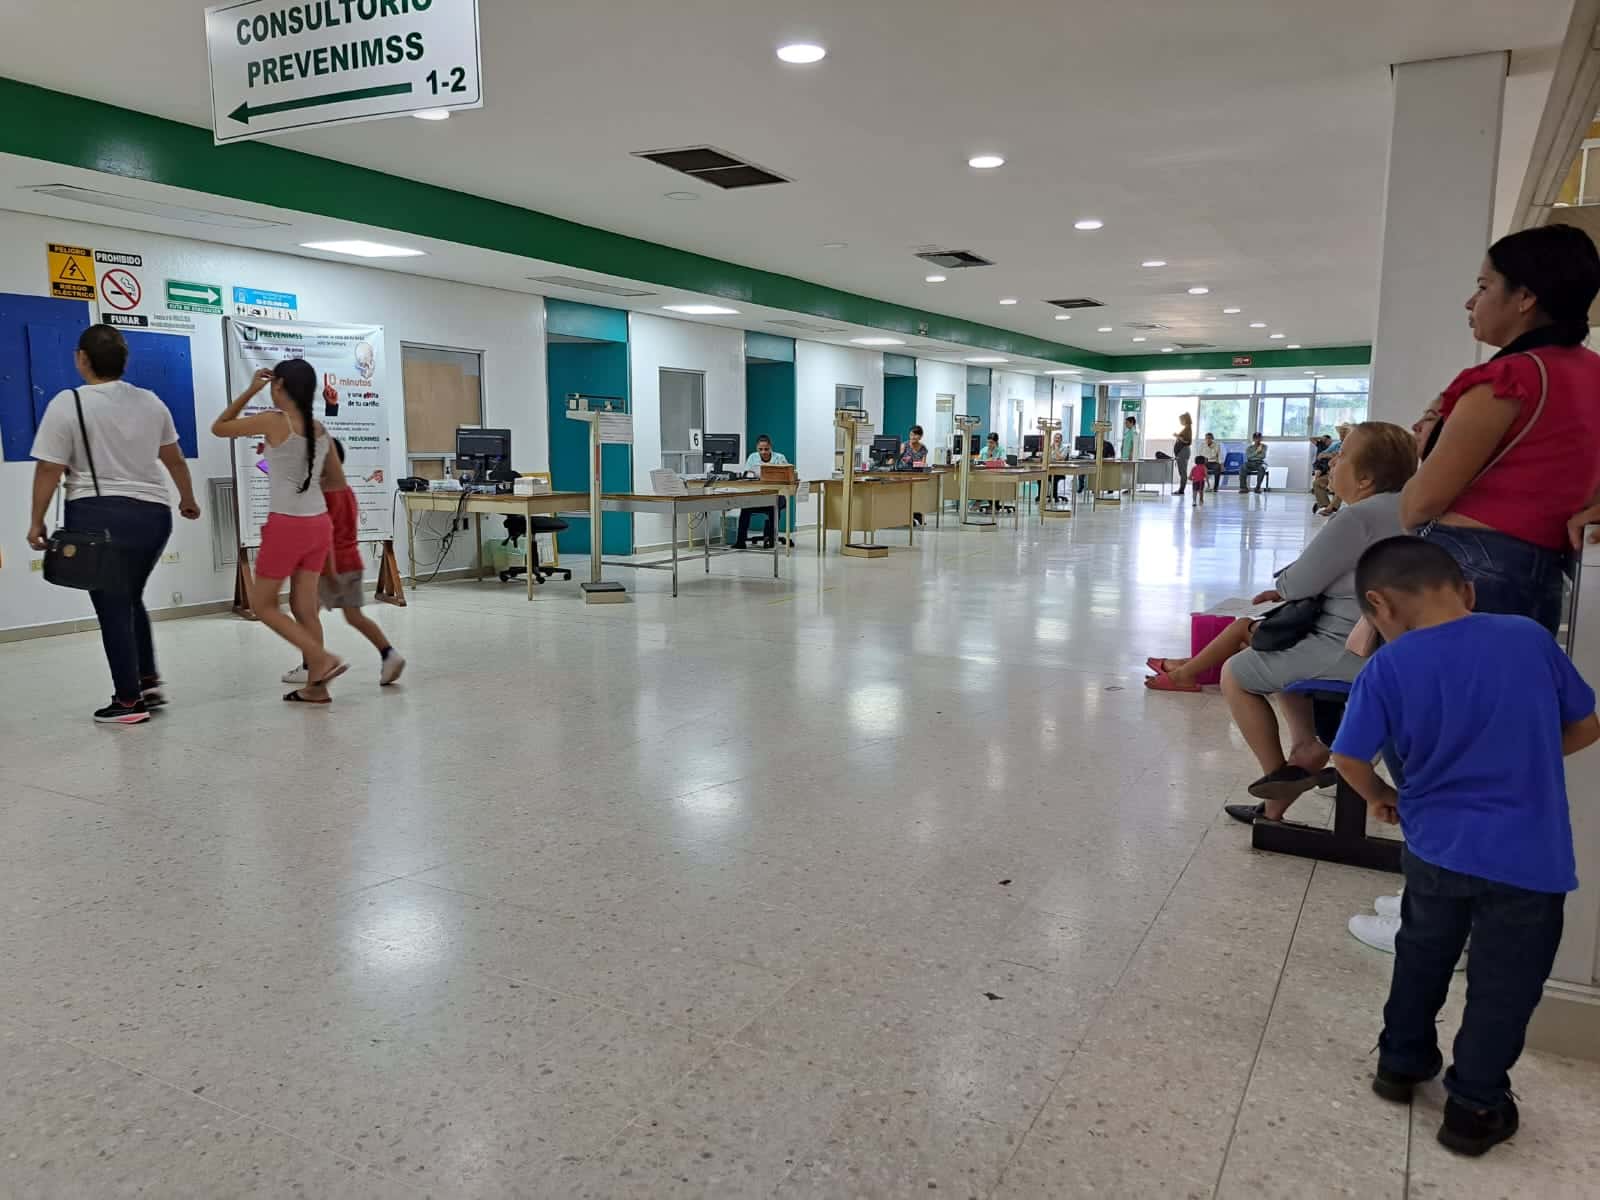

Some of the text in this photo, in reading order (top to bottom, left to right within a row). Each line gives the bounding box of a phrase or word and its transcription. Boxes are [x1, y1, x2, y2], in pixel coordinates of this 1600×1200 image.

[247, 32, 424, 88] PREVENIMSS
[425, 67, 467, 95] 1-2
[54, 246, 86, 256] PELIGRO
[96, 252, 141, 265] PROHIBIDO
[110, 315, 140, 325] FUMAR
[258, 330, 303, 340] PREVENIMSS
[340, 378, 372, 387] minutos
[693, 433, 699, 447] 6
